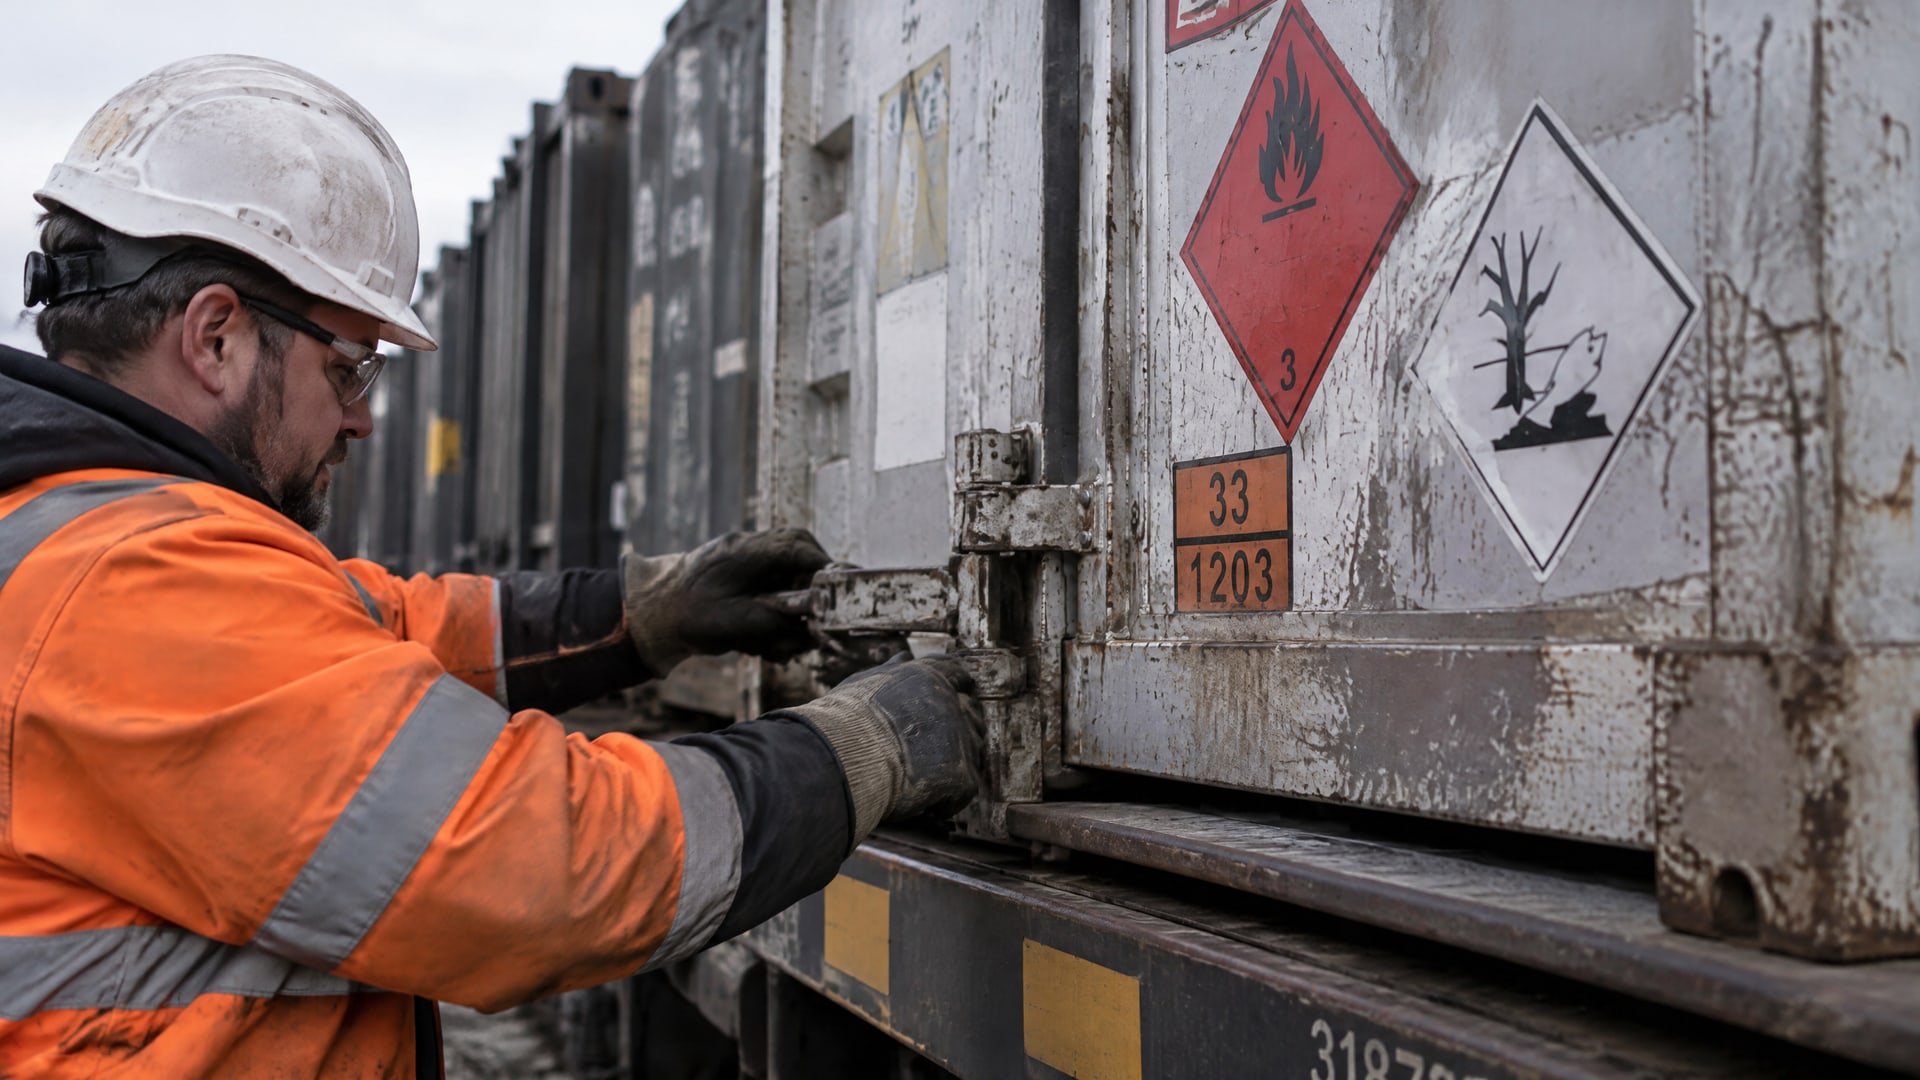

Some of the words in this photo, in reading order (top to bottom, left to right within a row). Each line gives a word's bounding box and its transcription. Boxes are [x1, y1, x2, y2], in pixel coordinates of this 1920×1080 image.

[1280, 348, 1297, 391] 3
[1209, 468, 1249, 527] 33
[1190, 547, 1273, 603] 1203
[1310, 1018, 1489, 1080] 318
